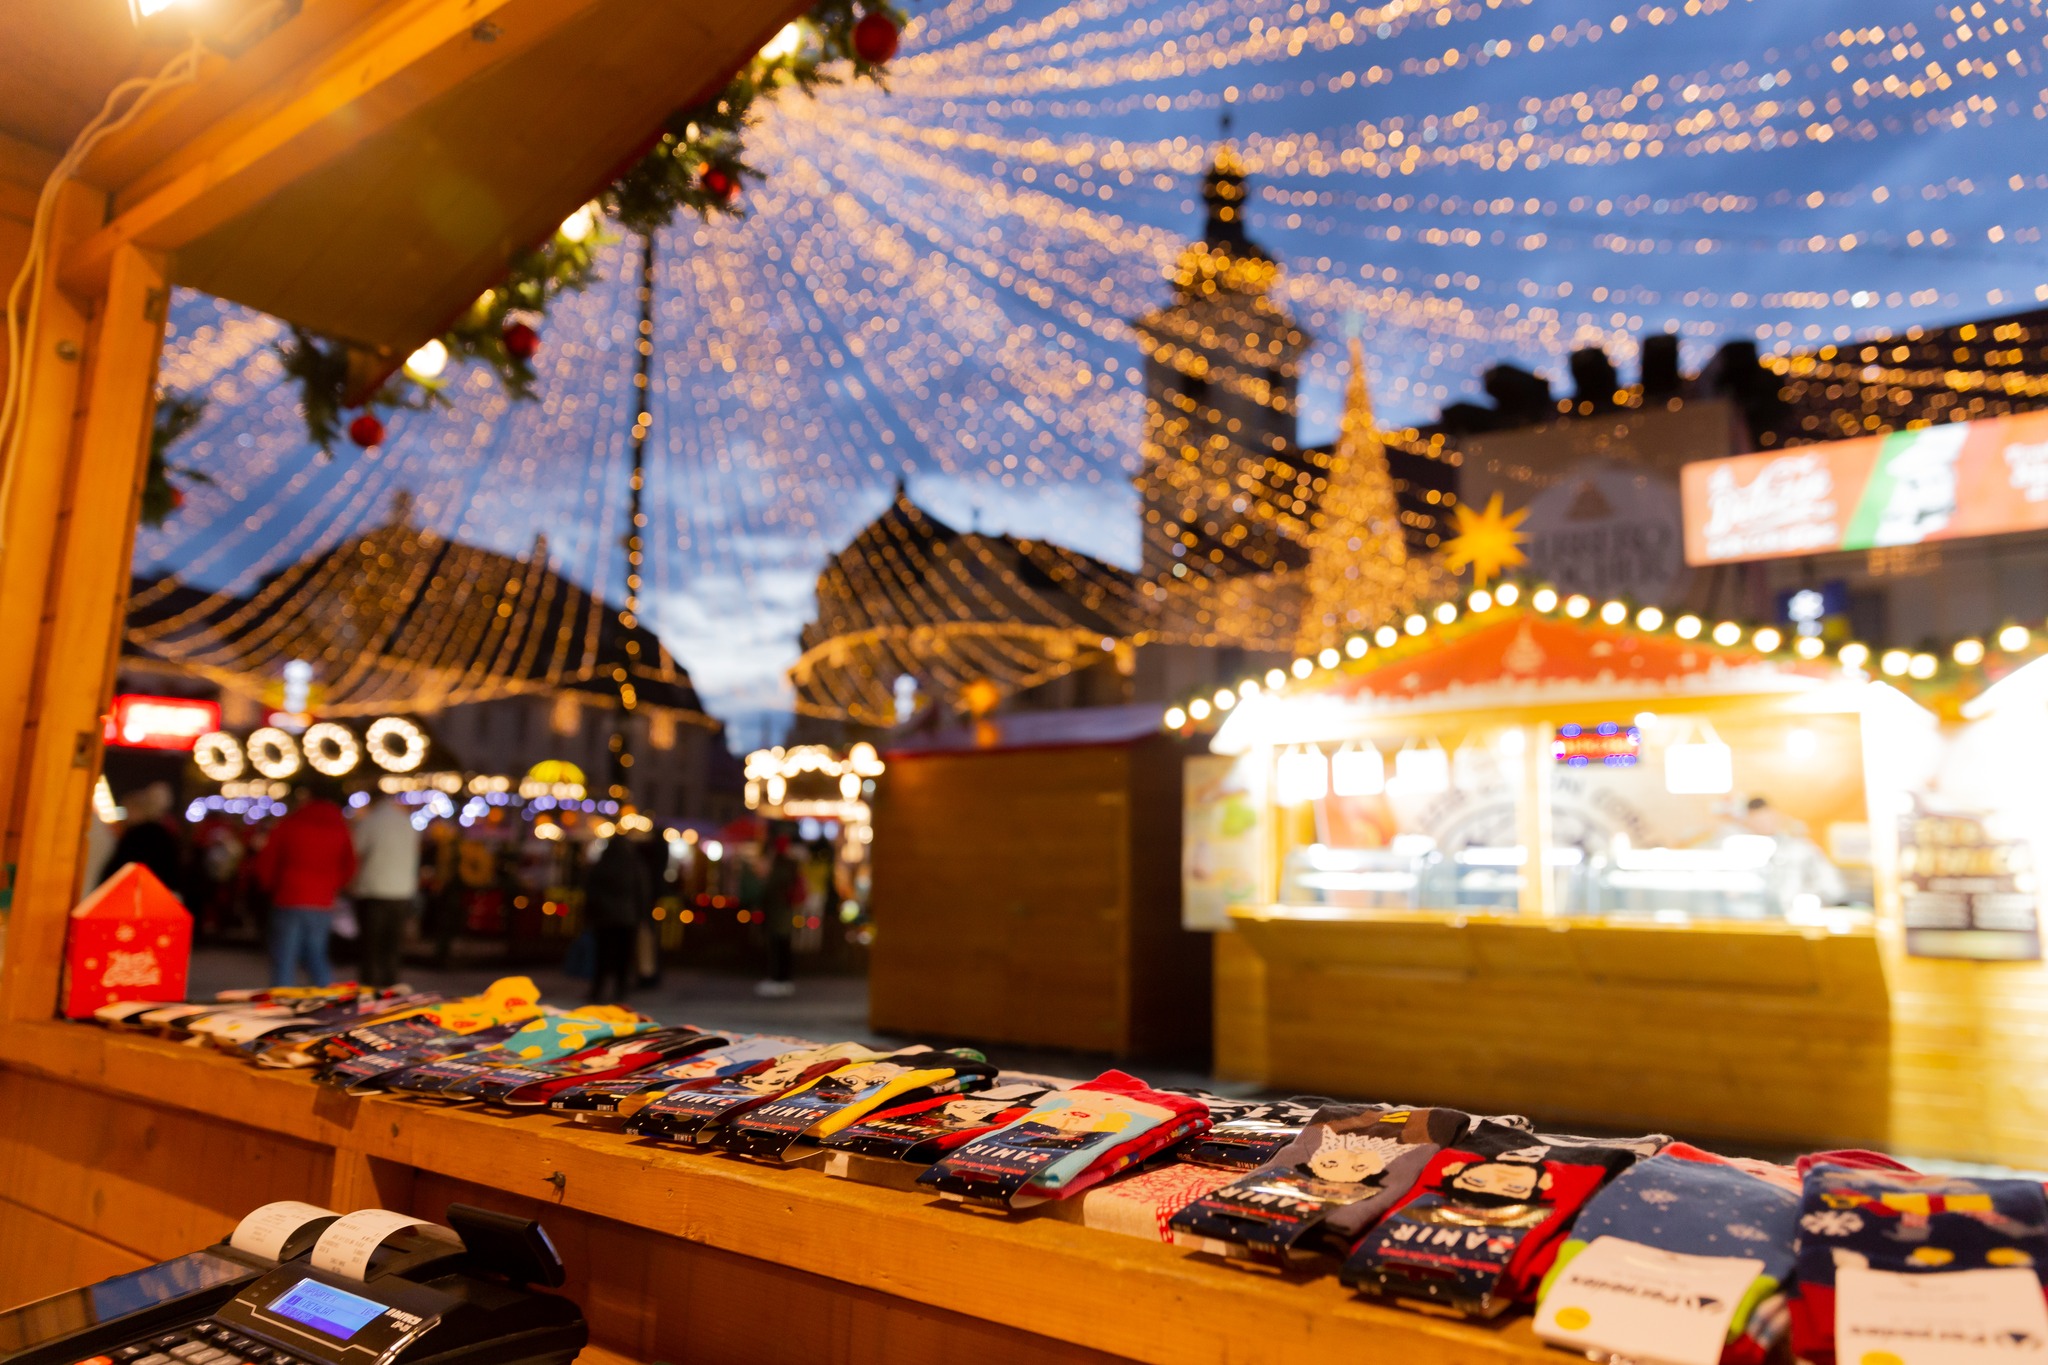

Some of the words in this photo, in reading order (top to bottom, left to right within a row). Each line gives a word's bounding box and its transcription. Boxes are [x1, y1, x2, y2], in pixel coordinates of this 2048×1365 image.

[758, 1104, 828, 1120] ZAMIR
[966, 1143, 1050, 1164] ZAMIR
[1218, 1186, 1321, 1213] ZAMIR
[1392, 1222, 1516, 1255] ZAMIR
